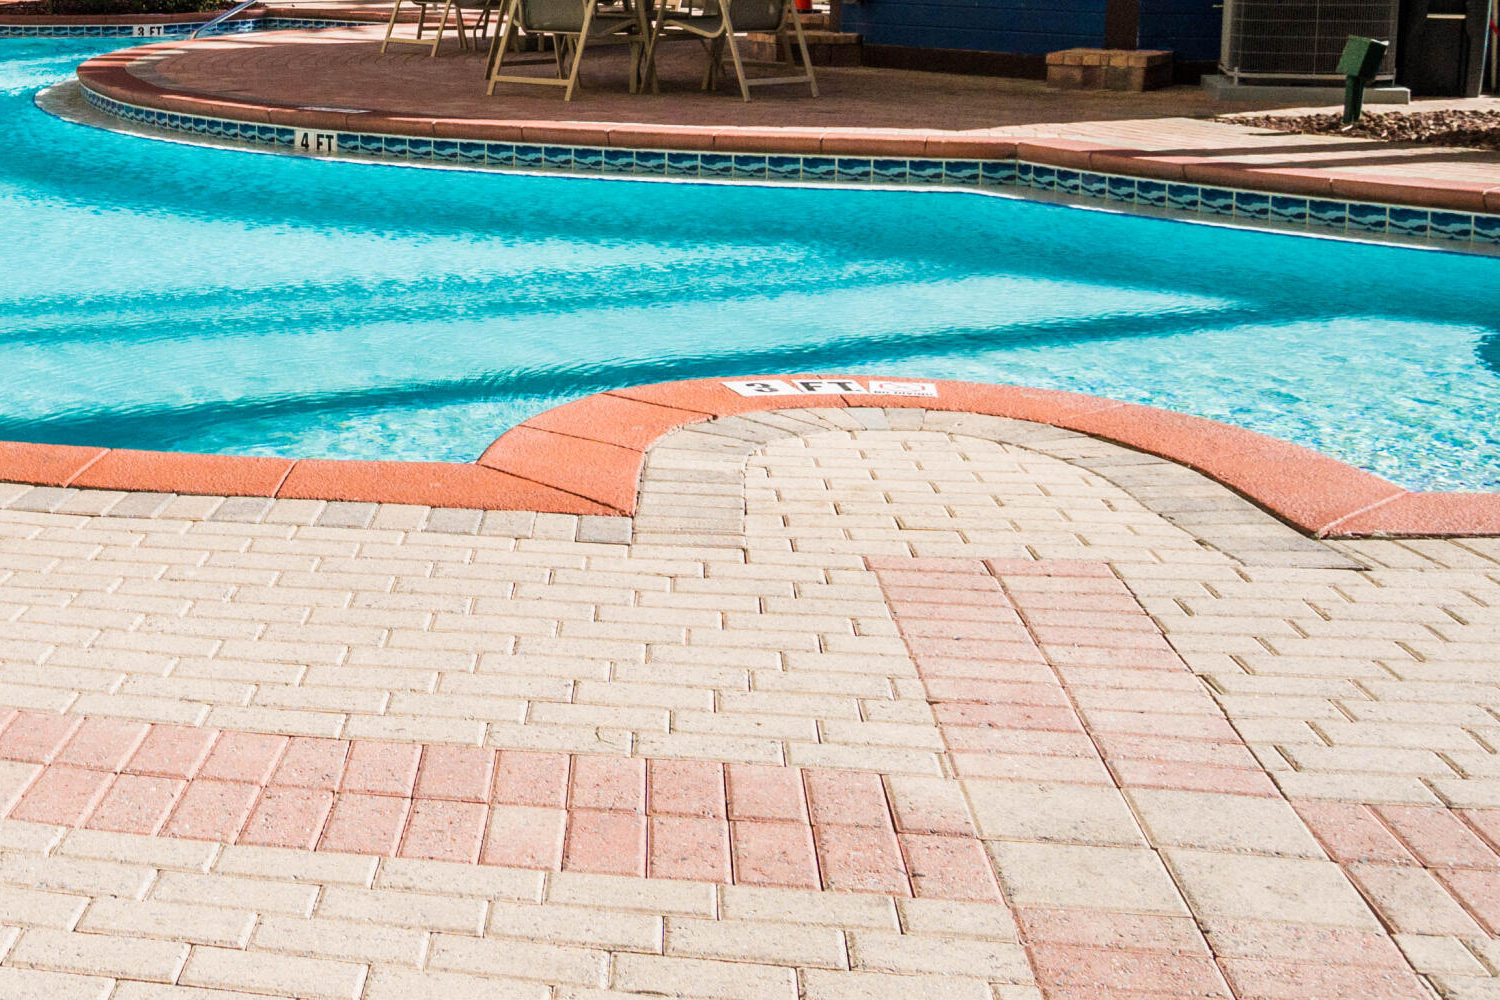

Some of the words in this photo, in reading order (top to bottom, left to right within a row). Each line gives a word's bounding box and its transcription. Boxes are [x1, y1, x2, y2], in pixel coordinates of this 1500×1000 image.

[149, 26, 162, 36] FT
[300, 132, 309, 150] 4
[316, 133, 334, 152] FT
[745, 382, 780, 393] 3
